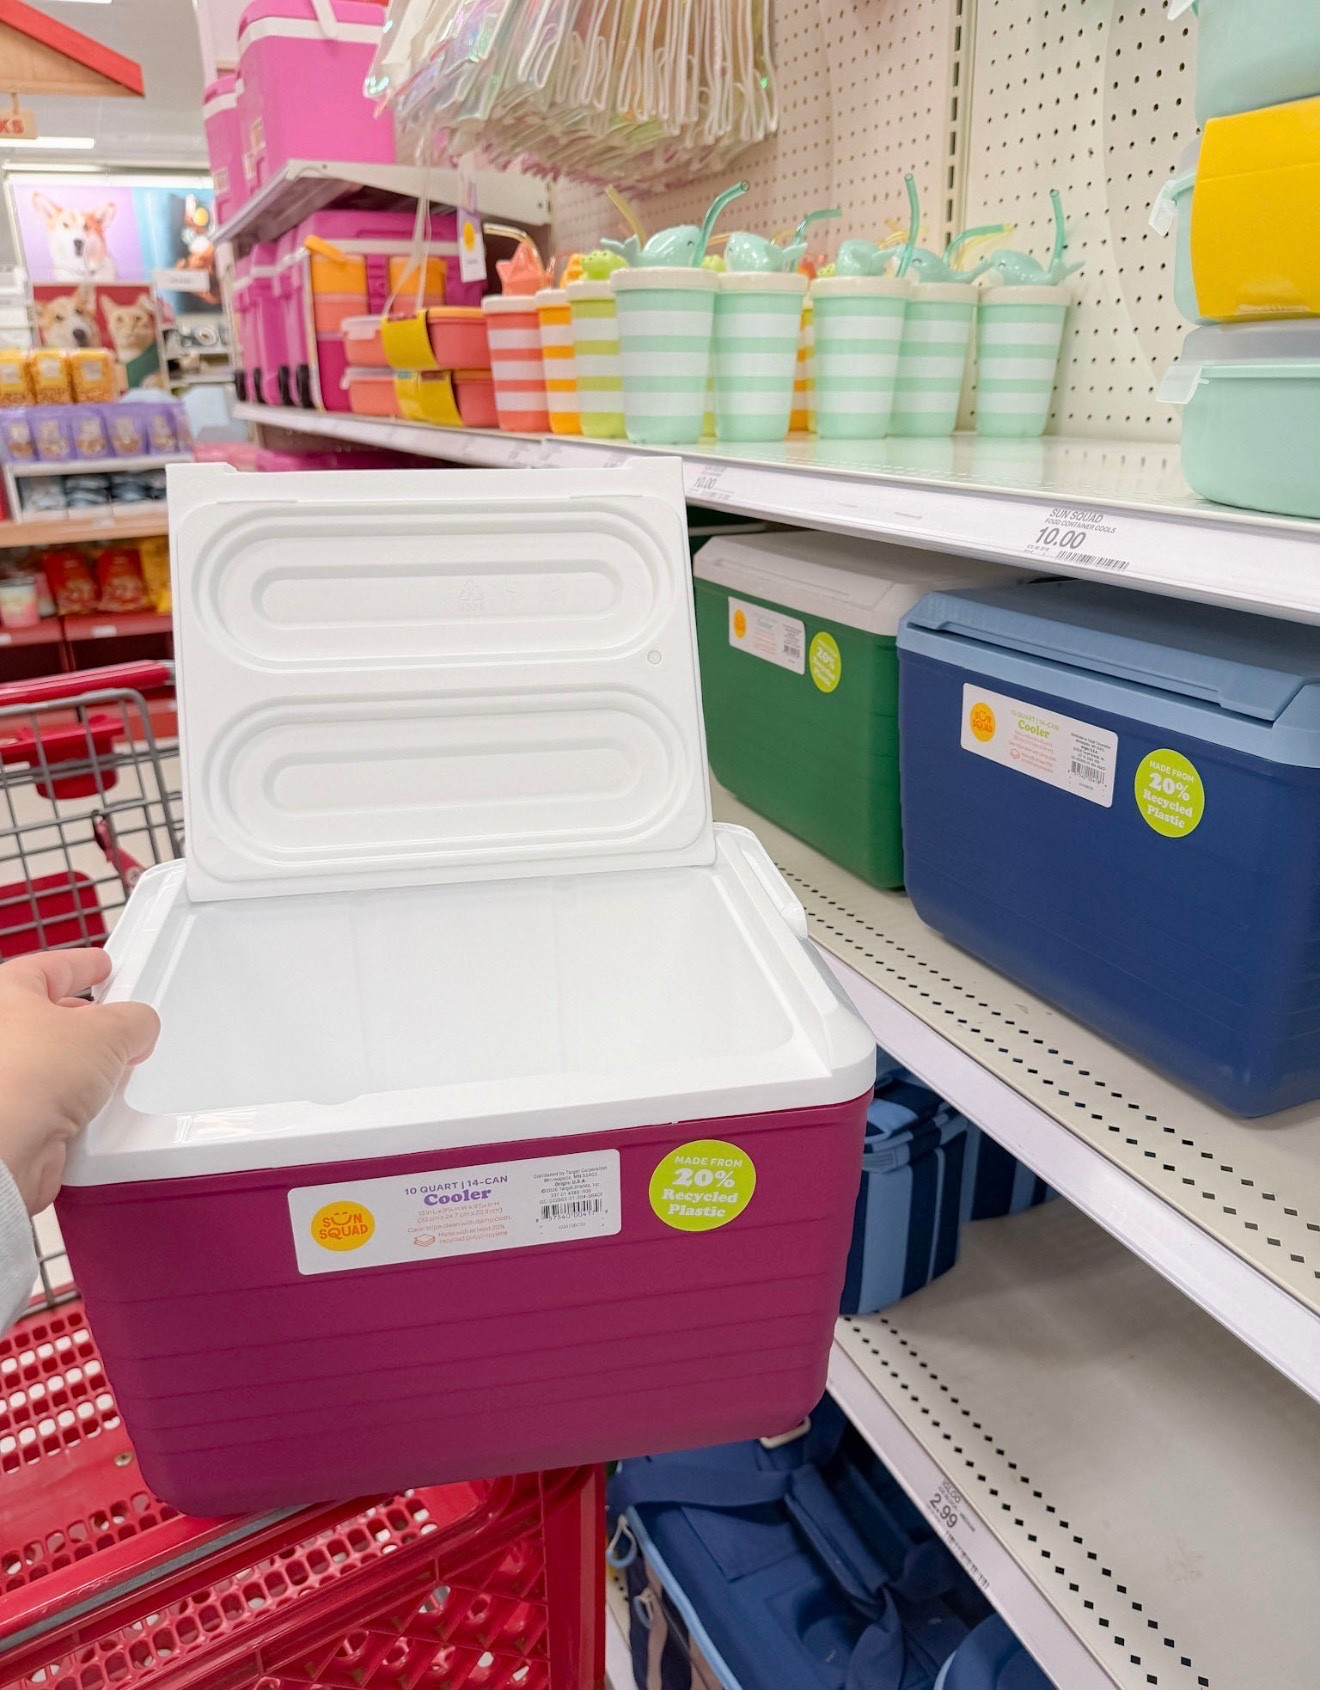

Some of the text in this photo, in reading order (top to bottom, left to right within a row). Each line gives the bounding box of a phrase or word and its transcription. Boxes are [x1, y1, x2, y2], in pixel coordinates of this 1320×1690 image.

[693, 475, 717, 490] 10.00
[1050, 508, 1103, 523] SUN SQUAD
[1045, 518, 1117, 534] FOOD CONTAINER COOLS
[1036, 526, 1086, 549] 10.00
[1018, 719, 1050, 738] Cooler
[1150, 760, 1194, 783] MADE FROM
[1149, 772, 1190, 801] 20%
[1143, 788, 1193, 818] Recycled
[1148, 804, 1185, 828] Plastic
[675, 1156, 742, 1168] MADE FROM
[420, 1182, 458, 1193] QUART
[467, 1175, 508, 1187] 14-CAN
[672, 1167, 735, 1188] 20%
[424, 1189, 491, 1206] Cooler
[662, 1188, 738, 1203] Recycled
[668, 1204, 725, 1217] Plastic
[322, 1213, 362, 1228] SUN
[319, 1224, 368, 1239] SQUAD
[930, 1493, 958, 1528] 2.99
